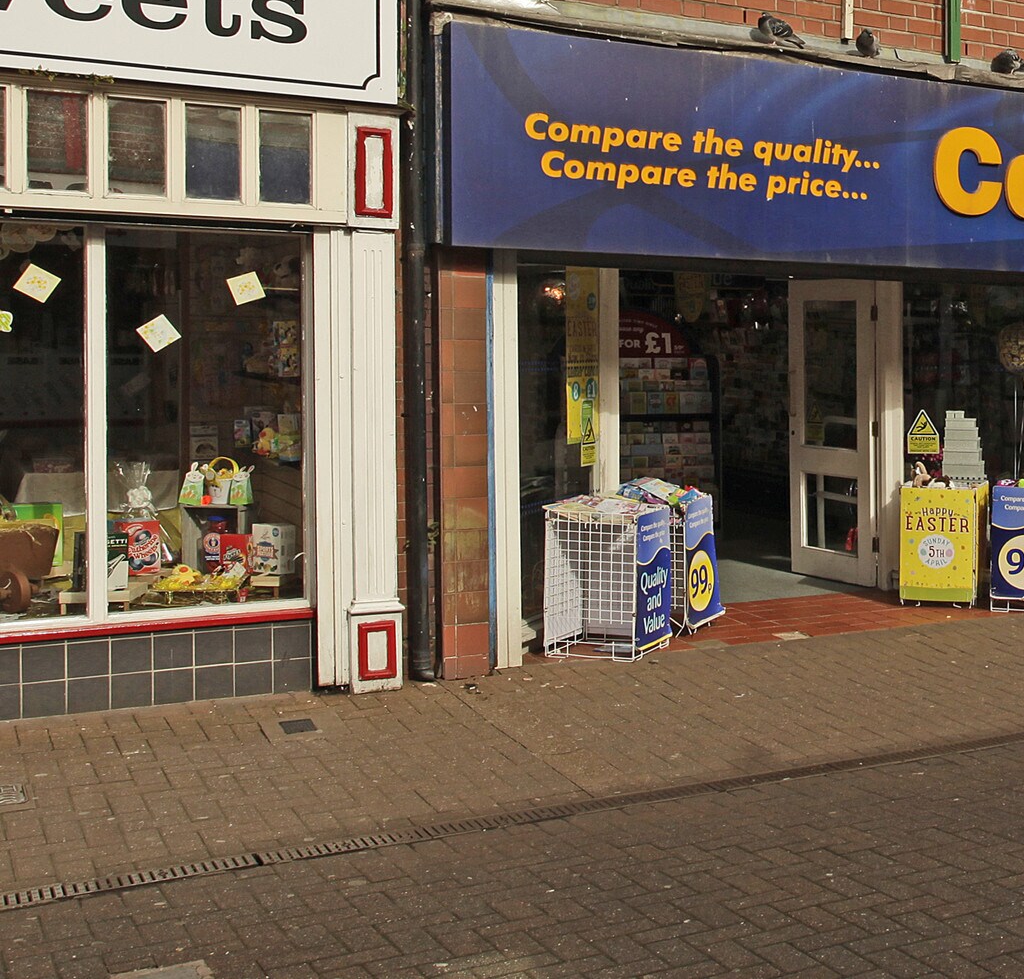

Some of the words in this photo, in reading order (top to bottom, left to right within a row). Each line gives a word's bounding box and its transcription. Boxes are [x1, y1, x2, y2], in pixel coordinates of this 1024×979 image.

[524, 112, 683, 153] Compare
[692, 128, 744, 157] the
[753, 138, 880, 172] quality...
[540, 150, 697, 190] Compare
[706, 163, 757, 192] the
[766, 171, 869, 201] price...
[619, 339, 641, 349] FOR
[645, 332, 673, 354] £1
[1000, 495, 1024, 504] Compare
[905, 515, 970, 533] EASTER
[923, 538, 950, 547] SUNDAY
[928, 545, 945, 558] 5TH
[925, 558, 948, 566] APRIL
[640, 566, 669, 595] Quality
[690, 564, 712, 599] 99p
[646, 587, 662, 612] and
[643, 613, 666, 635] Value
